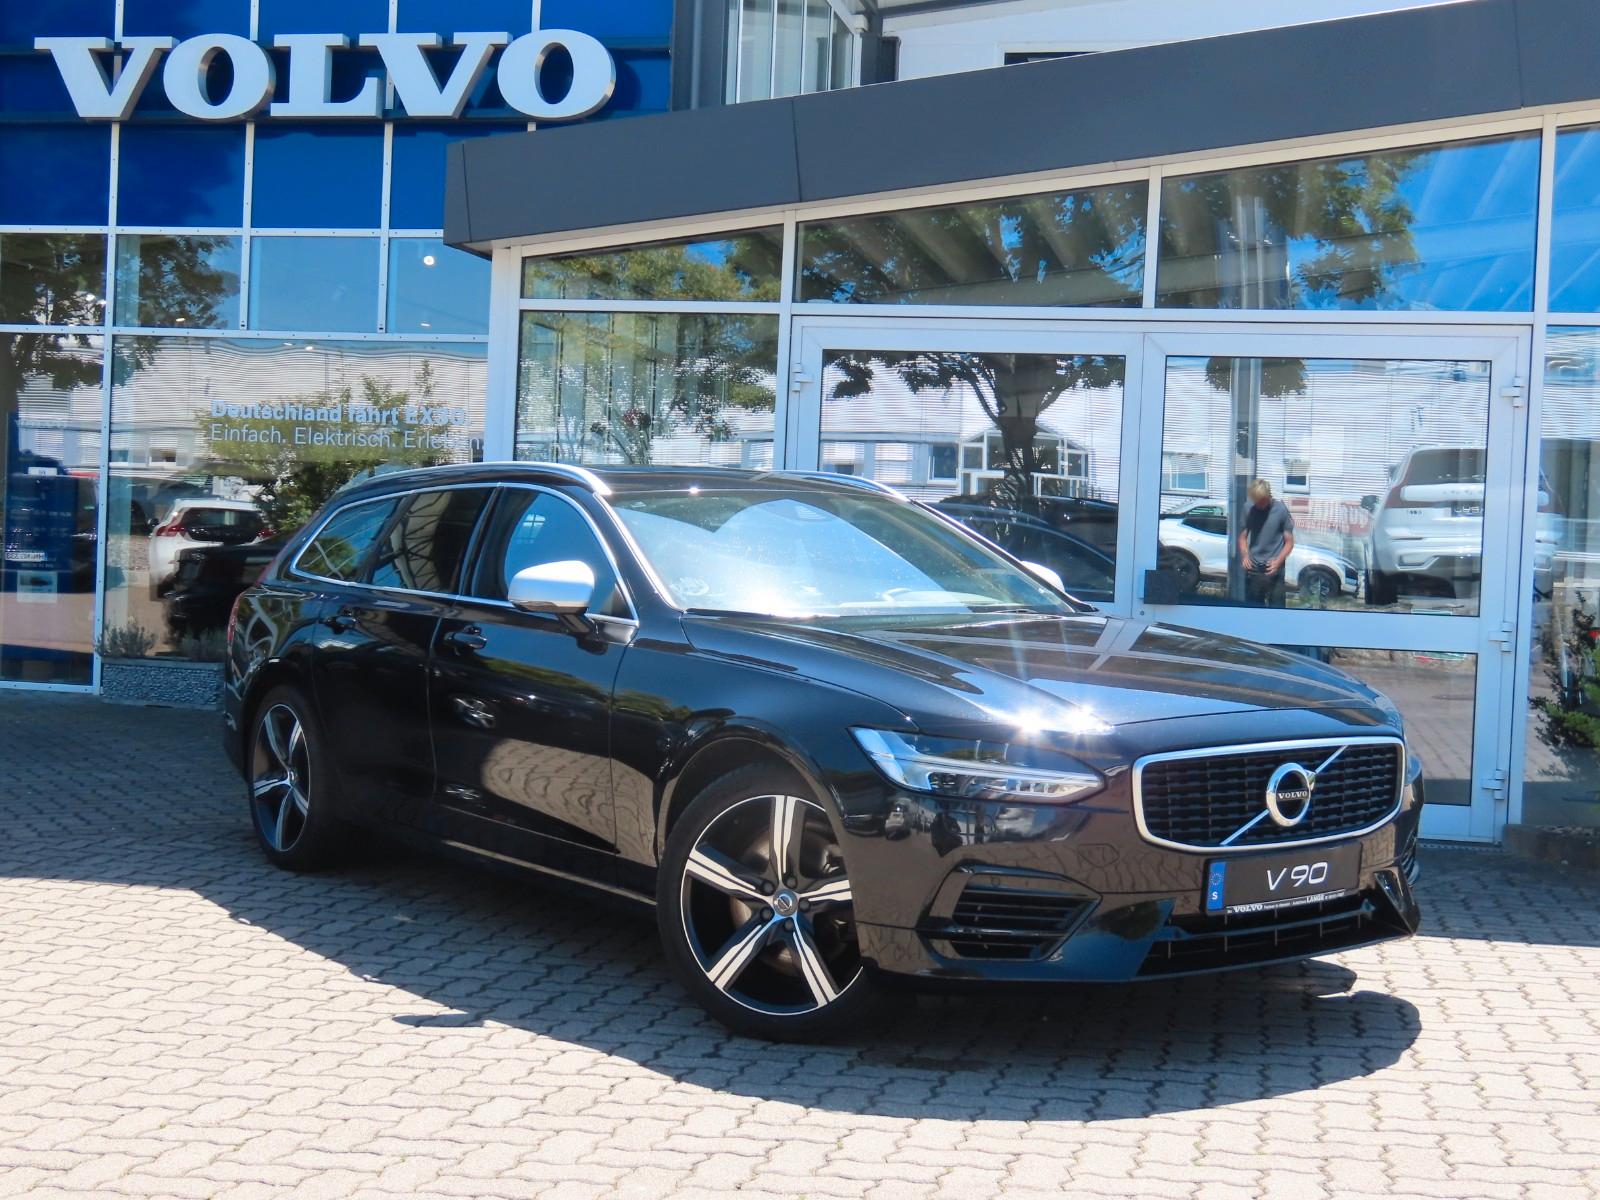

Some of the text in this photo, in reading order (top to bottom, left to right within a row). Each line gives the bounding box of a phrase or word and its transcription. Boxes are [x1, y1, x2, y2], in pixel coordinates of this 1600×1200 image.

[34, 28, 616, 120] VOLVO
[210, 400, 342, 422] Deutschland
[211, 423, 287, 444] Einfach.
[295, 426, 396, 448] Elektrisch.
[1278, 790, 1308, 799] VOLVO
[1211, 891, 1218, 900] S
[1233, 904, 1263, 914] VOLVO
